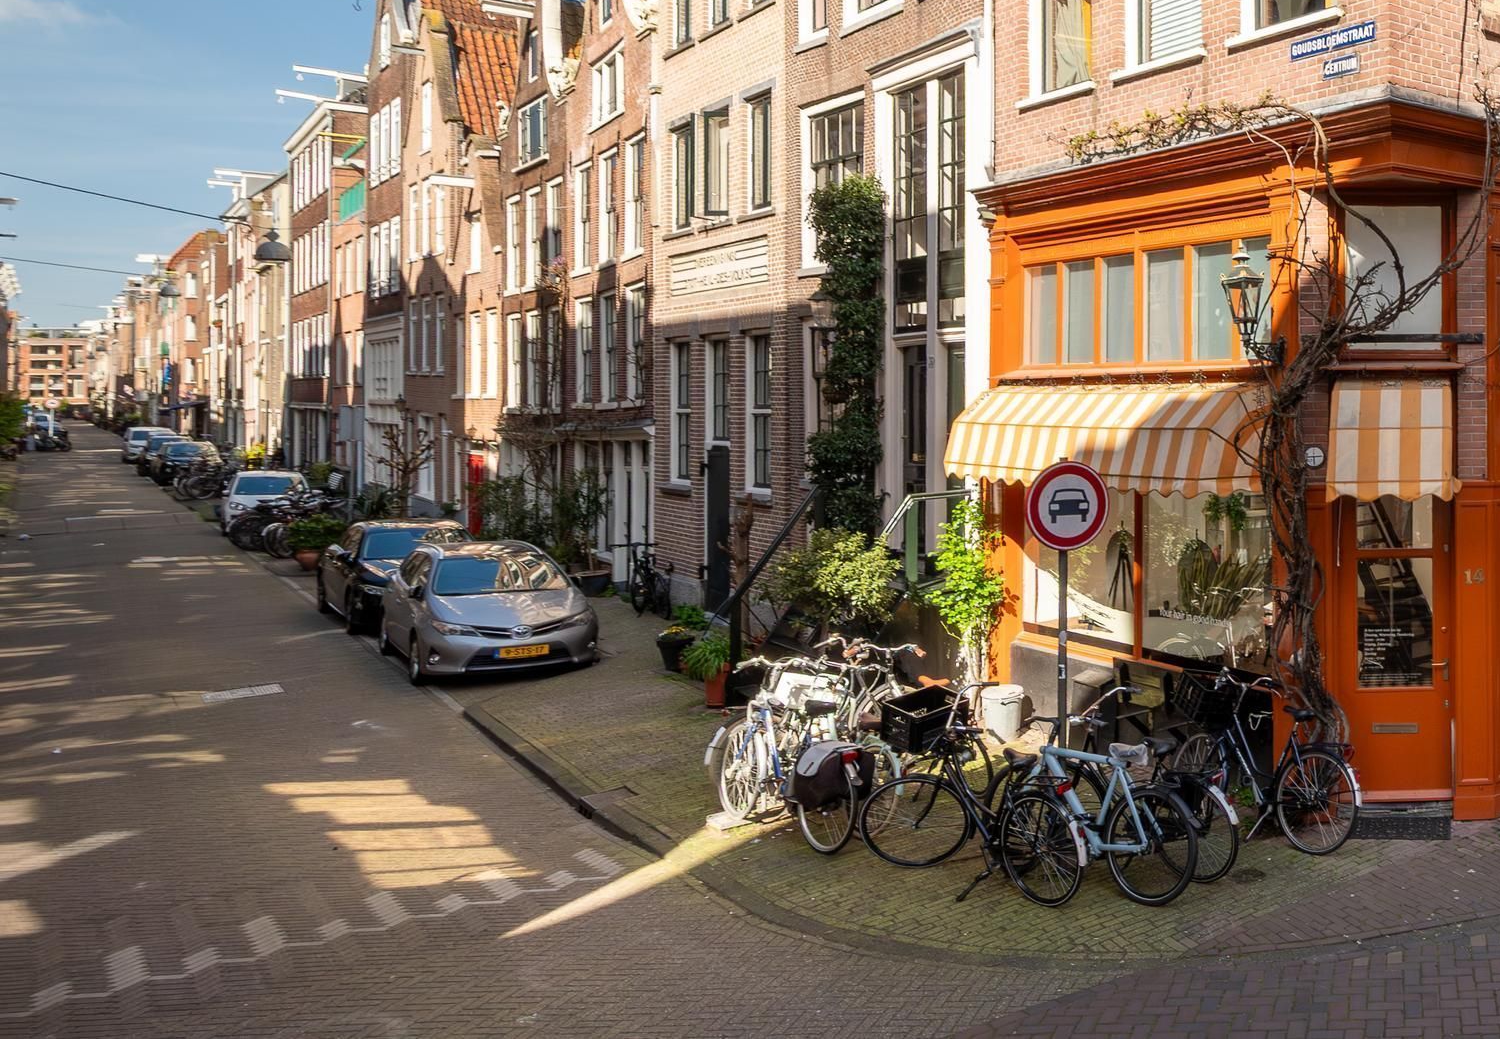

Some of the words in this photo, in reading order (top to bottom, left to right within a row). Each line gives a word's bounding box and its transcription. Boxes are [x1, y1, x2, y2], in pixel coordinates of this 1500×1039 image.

[1292, 25, 1374, 56] GOUDSBLOEMSTRAAT
[1325, 58, 1357, 75] CENTRUM
[1464, 568, 1485, 585] 14
[504, 645, 545, 656] 9-STS-17
